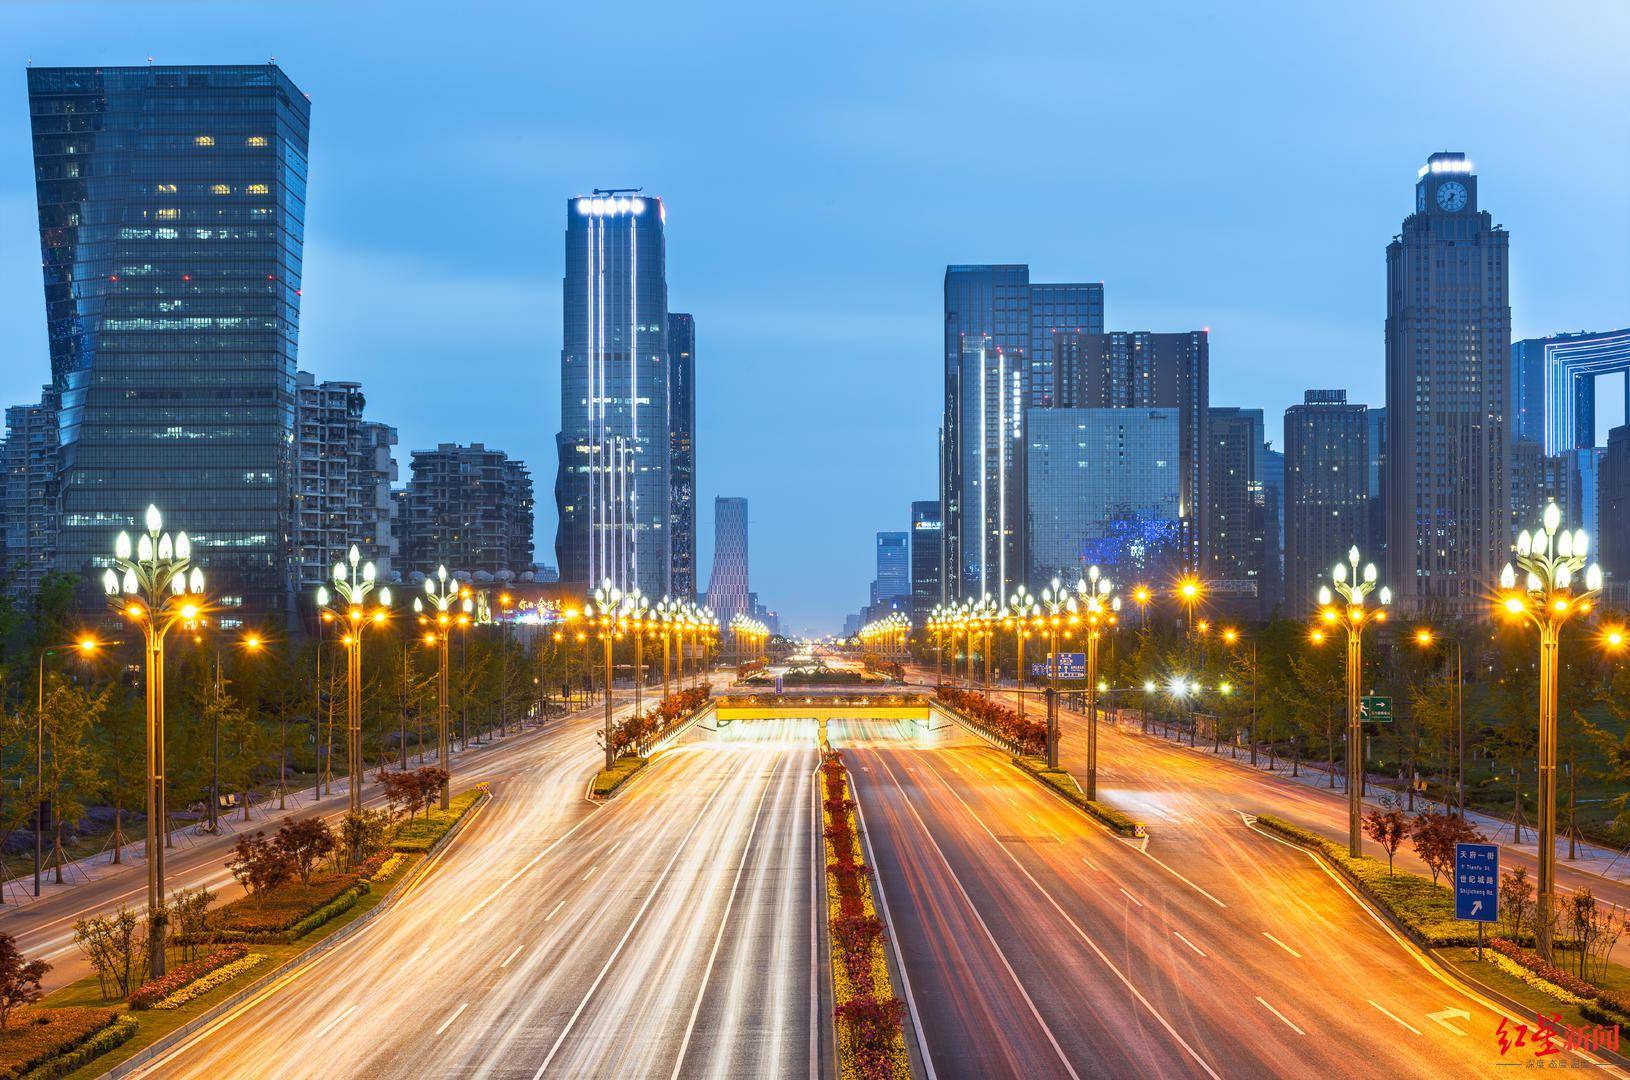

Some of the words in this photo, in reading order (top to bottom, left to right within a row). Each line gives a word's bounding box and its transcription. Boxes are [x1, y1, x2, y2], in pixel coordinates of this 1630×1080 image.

[1460, 850, 1494, 860] 天府一街
[1460, 874, 1494, 884] 世纪城路
